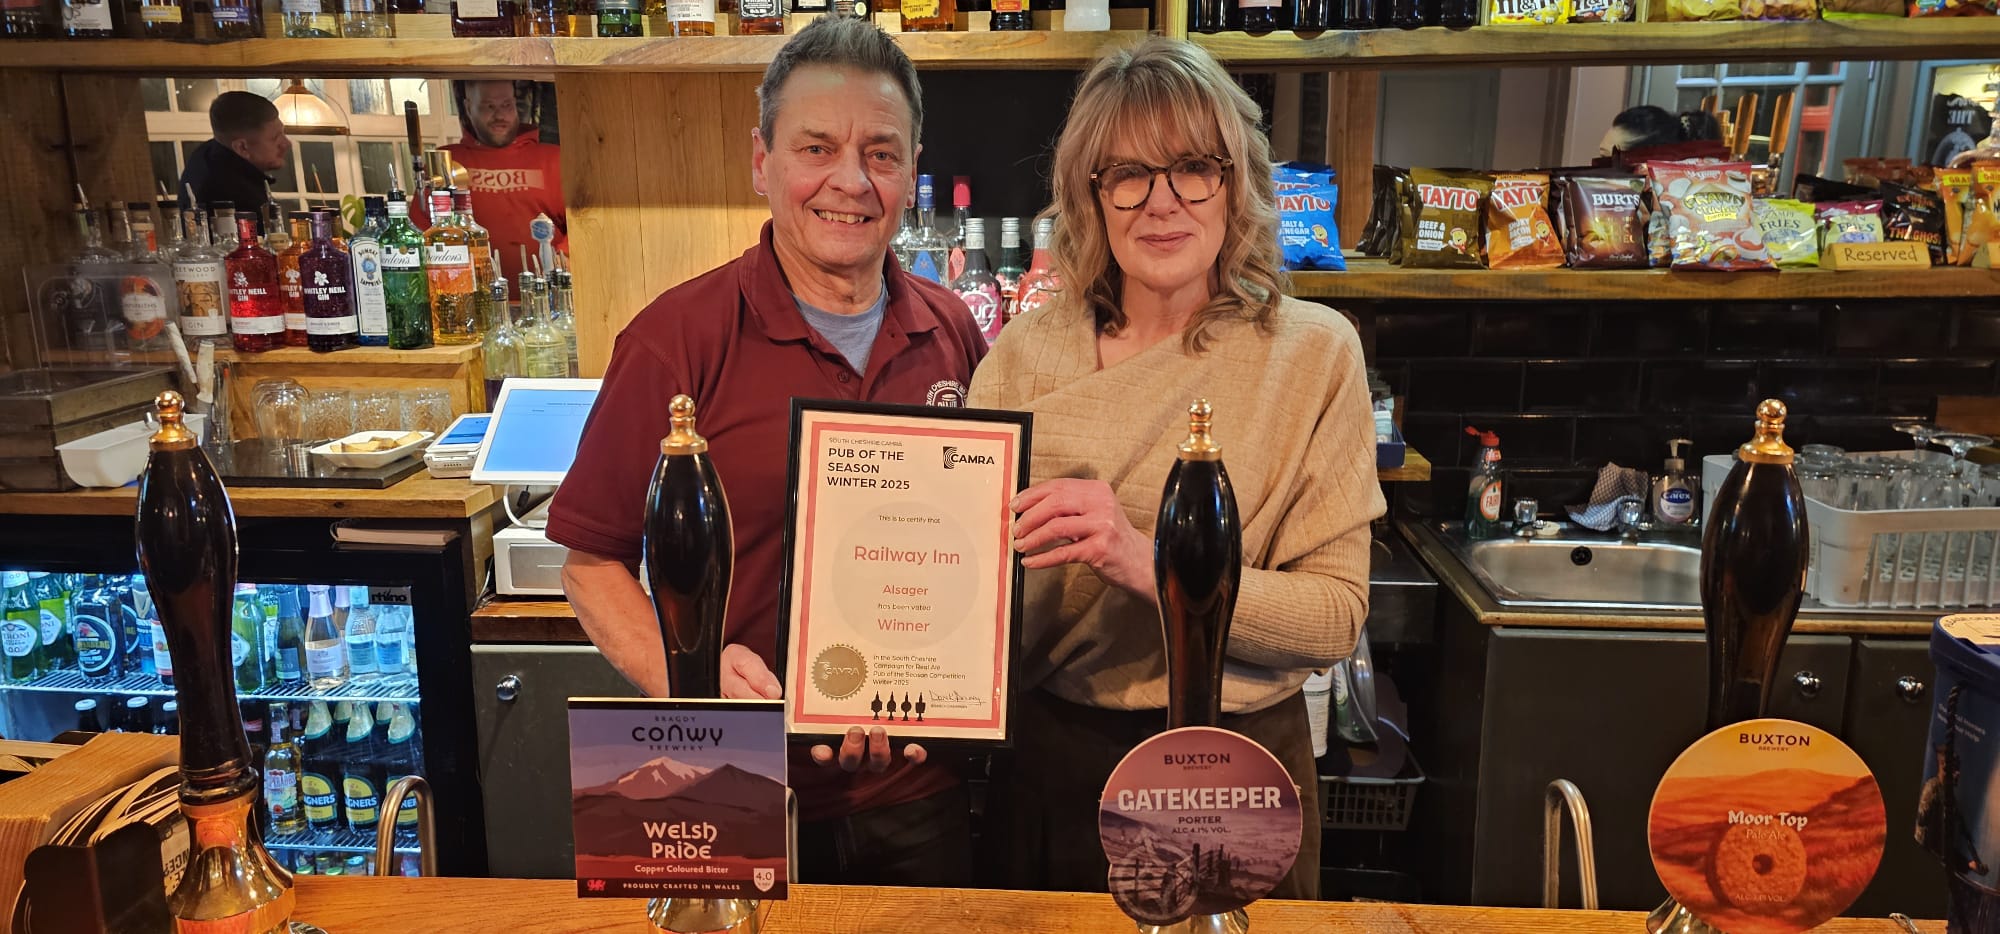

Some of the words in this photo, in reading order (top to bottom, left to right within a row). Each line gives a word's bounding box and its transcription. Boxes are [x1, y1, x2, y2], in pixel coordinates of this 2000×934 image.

[1418, 183, 1481, 212] TAYTO
[1592, 194, 1640, 207] BURTS
[1419, 220, 1438, 230] BEEF
[1758, 218, 1800, 232] FRIES
[1418, 230, 1444, 240] ONION
[1844, 245, 1918, 262] Reserved
[968, 303, 998, 318] urz
[828, 448, 855, 458] PUB
[858, 449, 876, 460] OF
[880, 450, 905, 461] THE
[950, 454, 994, 465] CAMRA
[828, 462, 880, 474] SEASON
[826, 476, 877, 488] WINTER
[880, 478, 910, 490] 2025
[1662, 492, 1690, 500] Carex
[906, 516, 926, 524] certify
[854, 546, 927, 566] Railway
[934, 550, 960, 565] Inn
[371, 589, 407, 602] rhino
[882, 584, 929, 597] Alsager
[878, 618, 930, 632] Winner
[1738, 733, 1811, 746] BUXTON
[1164, 753, 1231, 765] BUXTON
[1118, 786, 1282, 812] GATEKEEPER
[1178, 816, 1222, 824] PORTER
[1728, 810, 1774, 826] Moor
[1777, 812, 1808, 831] Top
[634, 864, 664, 876] Copper
[666, 864, 704, 874] Coloured
[705, 866, 728, 875] Bitter
[756, 872, 772, 880] 4.0
